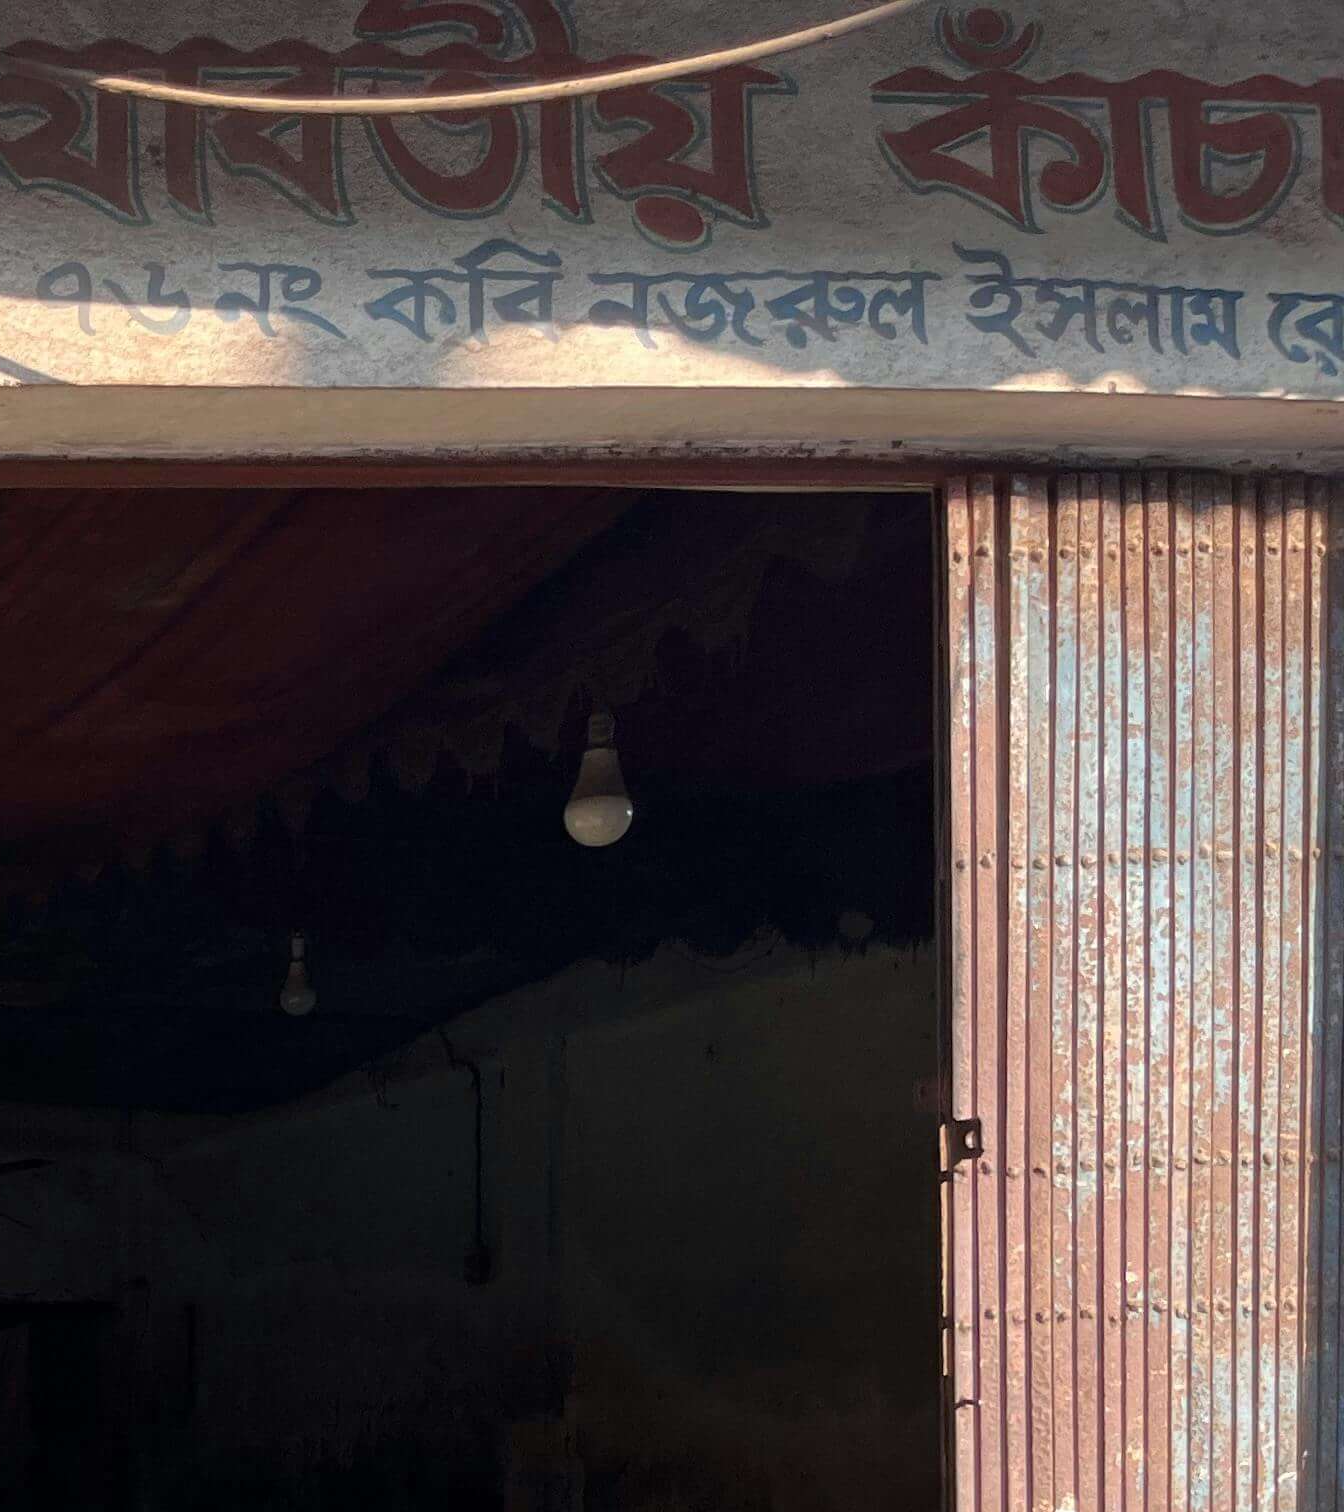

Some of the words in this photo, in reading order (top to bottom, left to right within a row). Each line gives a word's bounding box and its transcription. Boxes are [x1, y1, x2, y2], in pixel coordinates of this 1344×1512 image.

[214, 262, 346, 340] নং
[364, 238, 562, 344] কবি
[588, 268, 943, 349] নজরুল
[952, 241, 1245, 361] ইসলাম
